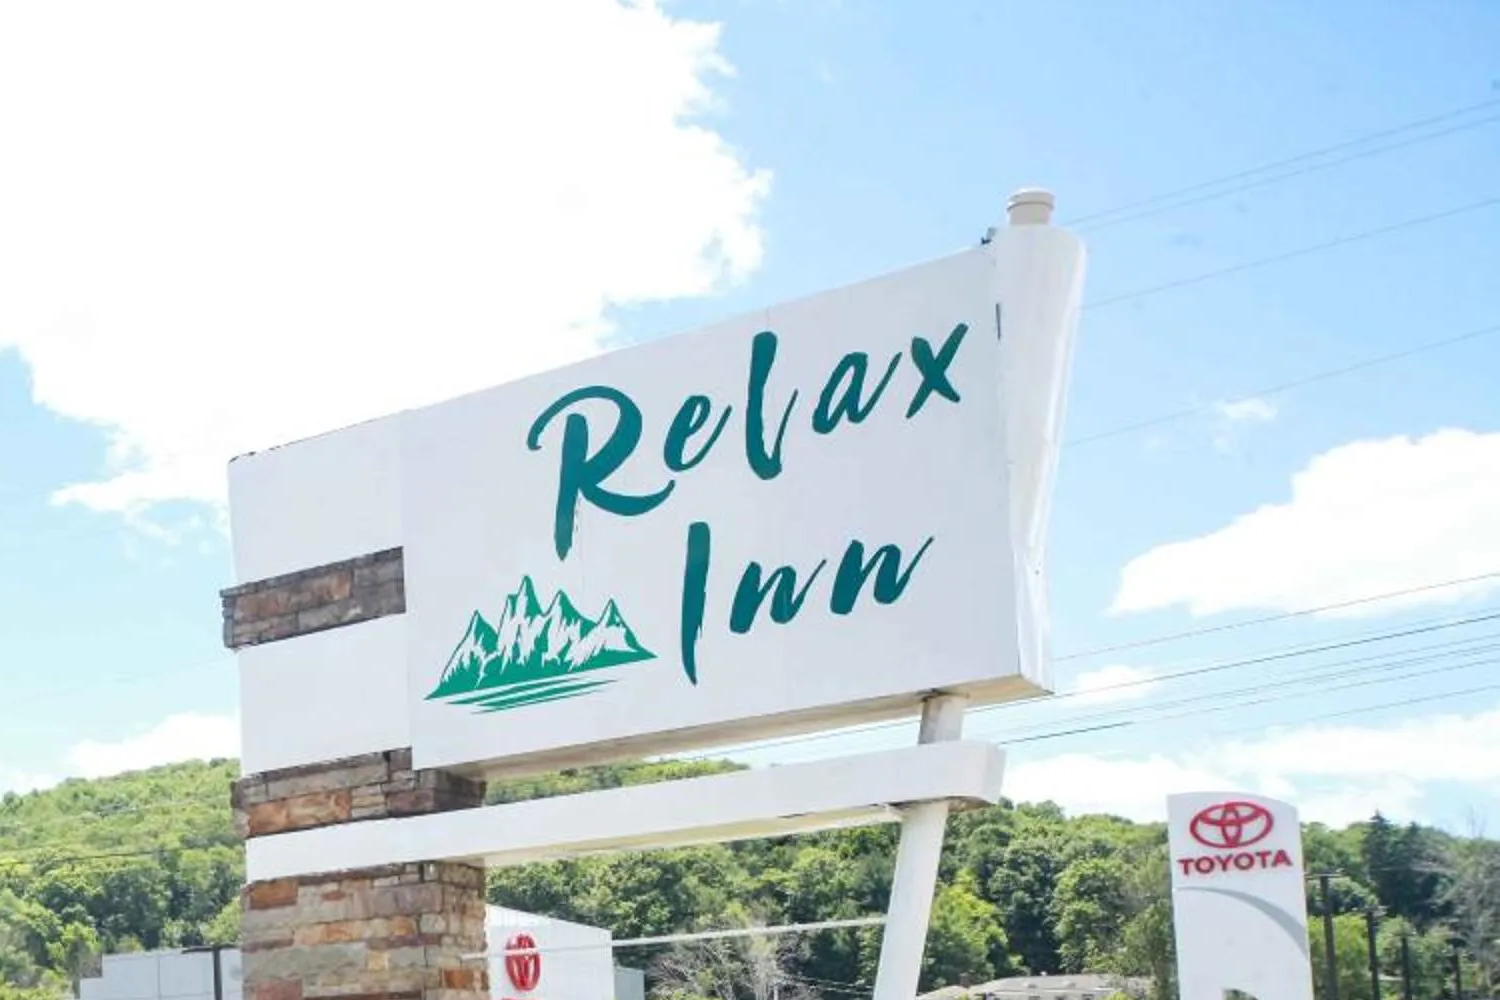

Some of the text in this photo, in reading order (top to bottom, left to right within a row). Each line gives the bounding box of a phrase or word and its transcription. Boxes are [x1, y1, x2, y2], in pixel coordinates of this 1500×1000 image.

[527, 323, 969, 561] Relax
[681, 522, 934, 685] Inn
[1177, 849, 1293, 875] TOYOTA
